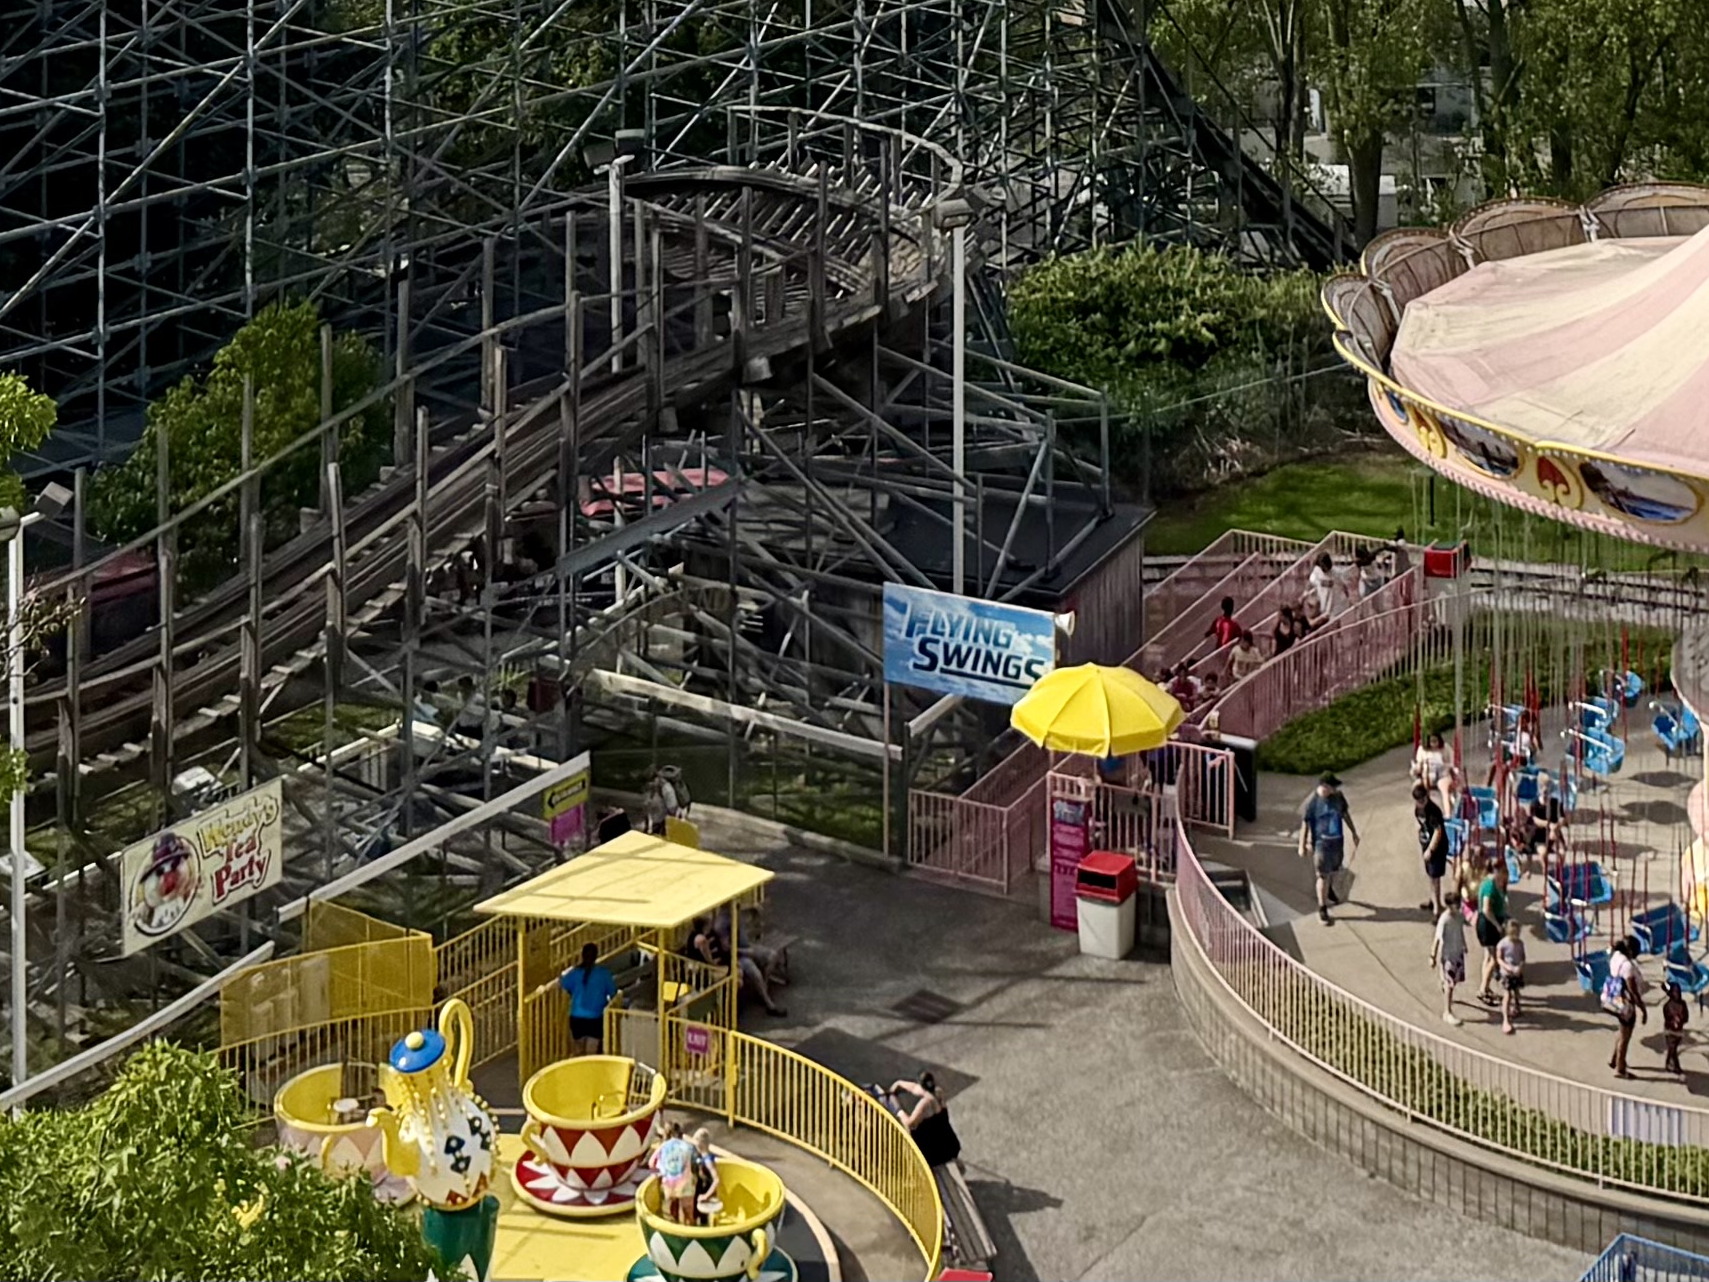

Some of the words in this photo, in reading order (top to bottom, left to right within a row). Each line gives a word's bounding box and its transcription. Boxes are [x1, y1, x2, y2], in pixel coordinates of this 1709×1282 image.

[904, 602, 1015, 650] FLYING
[911, 636, 1045, 683] SWINGS
[225, 835, 257, 862] Tea
[214, 855, 268, 899] Party
